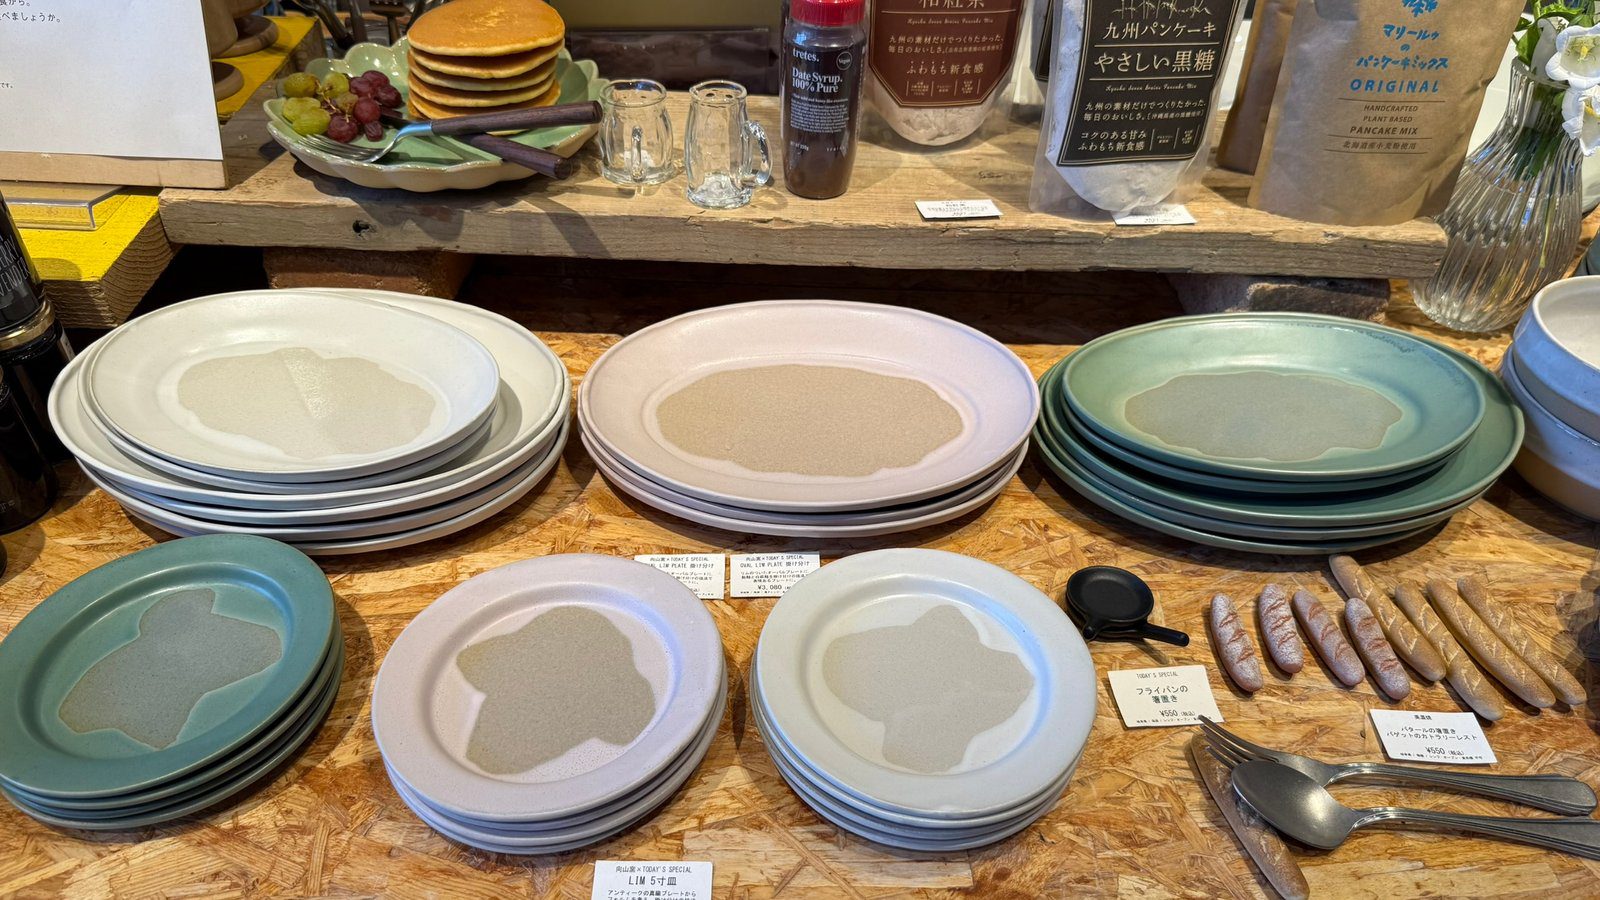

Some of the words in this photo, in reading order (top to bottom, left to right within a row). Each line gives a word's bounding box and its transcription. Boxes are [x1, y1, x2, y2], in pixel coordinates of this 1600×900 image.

[0, 12, 61, 22] べましょうか。
[1102, 22, 1217, 40] 九州パンケーキ
[1400, 43, 1411, 52] の
[792, 48, 820, 62] tretes.
[1094, 49, 1216, 73] やさしい黒糖
[1356, 54, 1449, 71] パンケーキミックス
[906, 61, 984, 75] ふわもち新食感
[792, 67, 811, 80] Date
[812, 71, 843, 86] Syrup.
[792, 77, 815, 92] 100%
[816, 82, 839, 93] Pure
[1349, 79, 1440, 93] ORIGINAL
[1363, 104, 1418, 112] HANDCRAFTED
[1363, 115, 1387, 123] PLANT
[1081, 129, 1146, 140] コクのある甘み
[1350, 126, 1397, 135] PANCAKE
[1398, 127, 1418, 135] MIX
[1077, 141, 1145, 152] ふわもち新食感
[1136, 685, 1188, 695] フライパンの
[1159, 709, 1178, 717] ¥550
[1425, 746, 1445, 755] ¥550
[628, 875, 646, 886] LIM
[650, 875, 677, 886] 5寸皿
